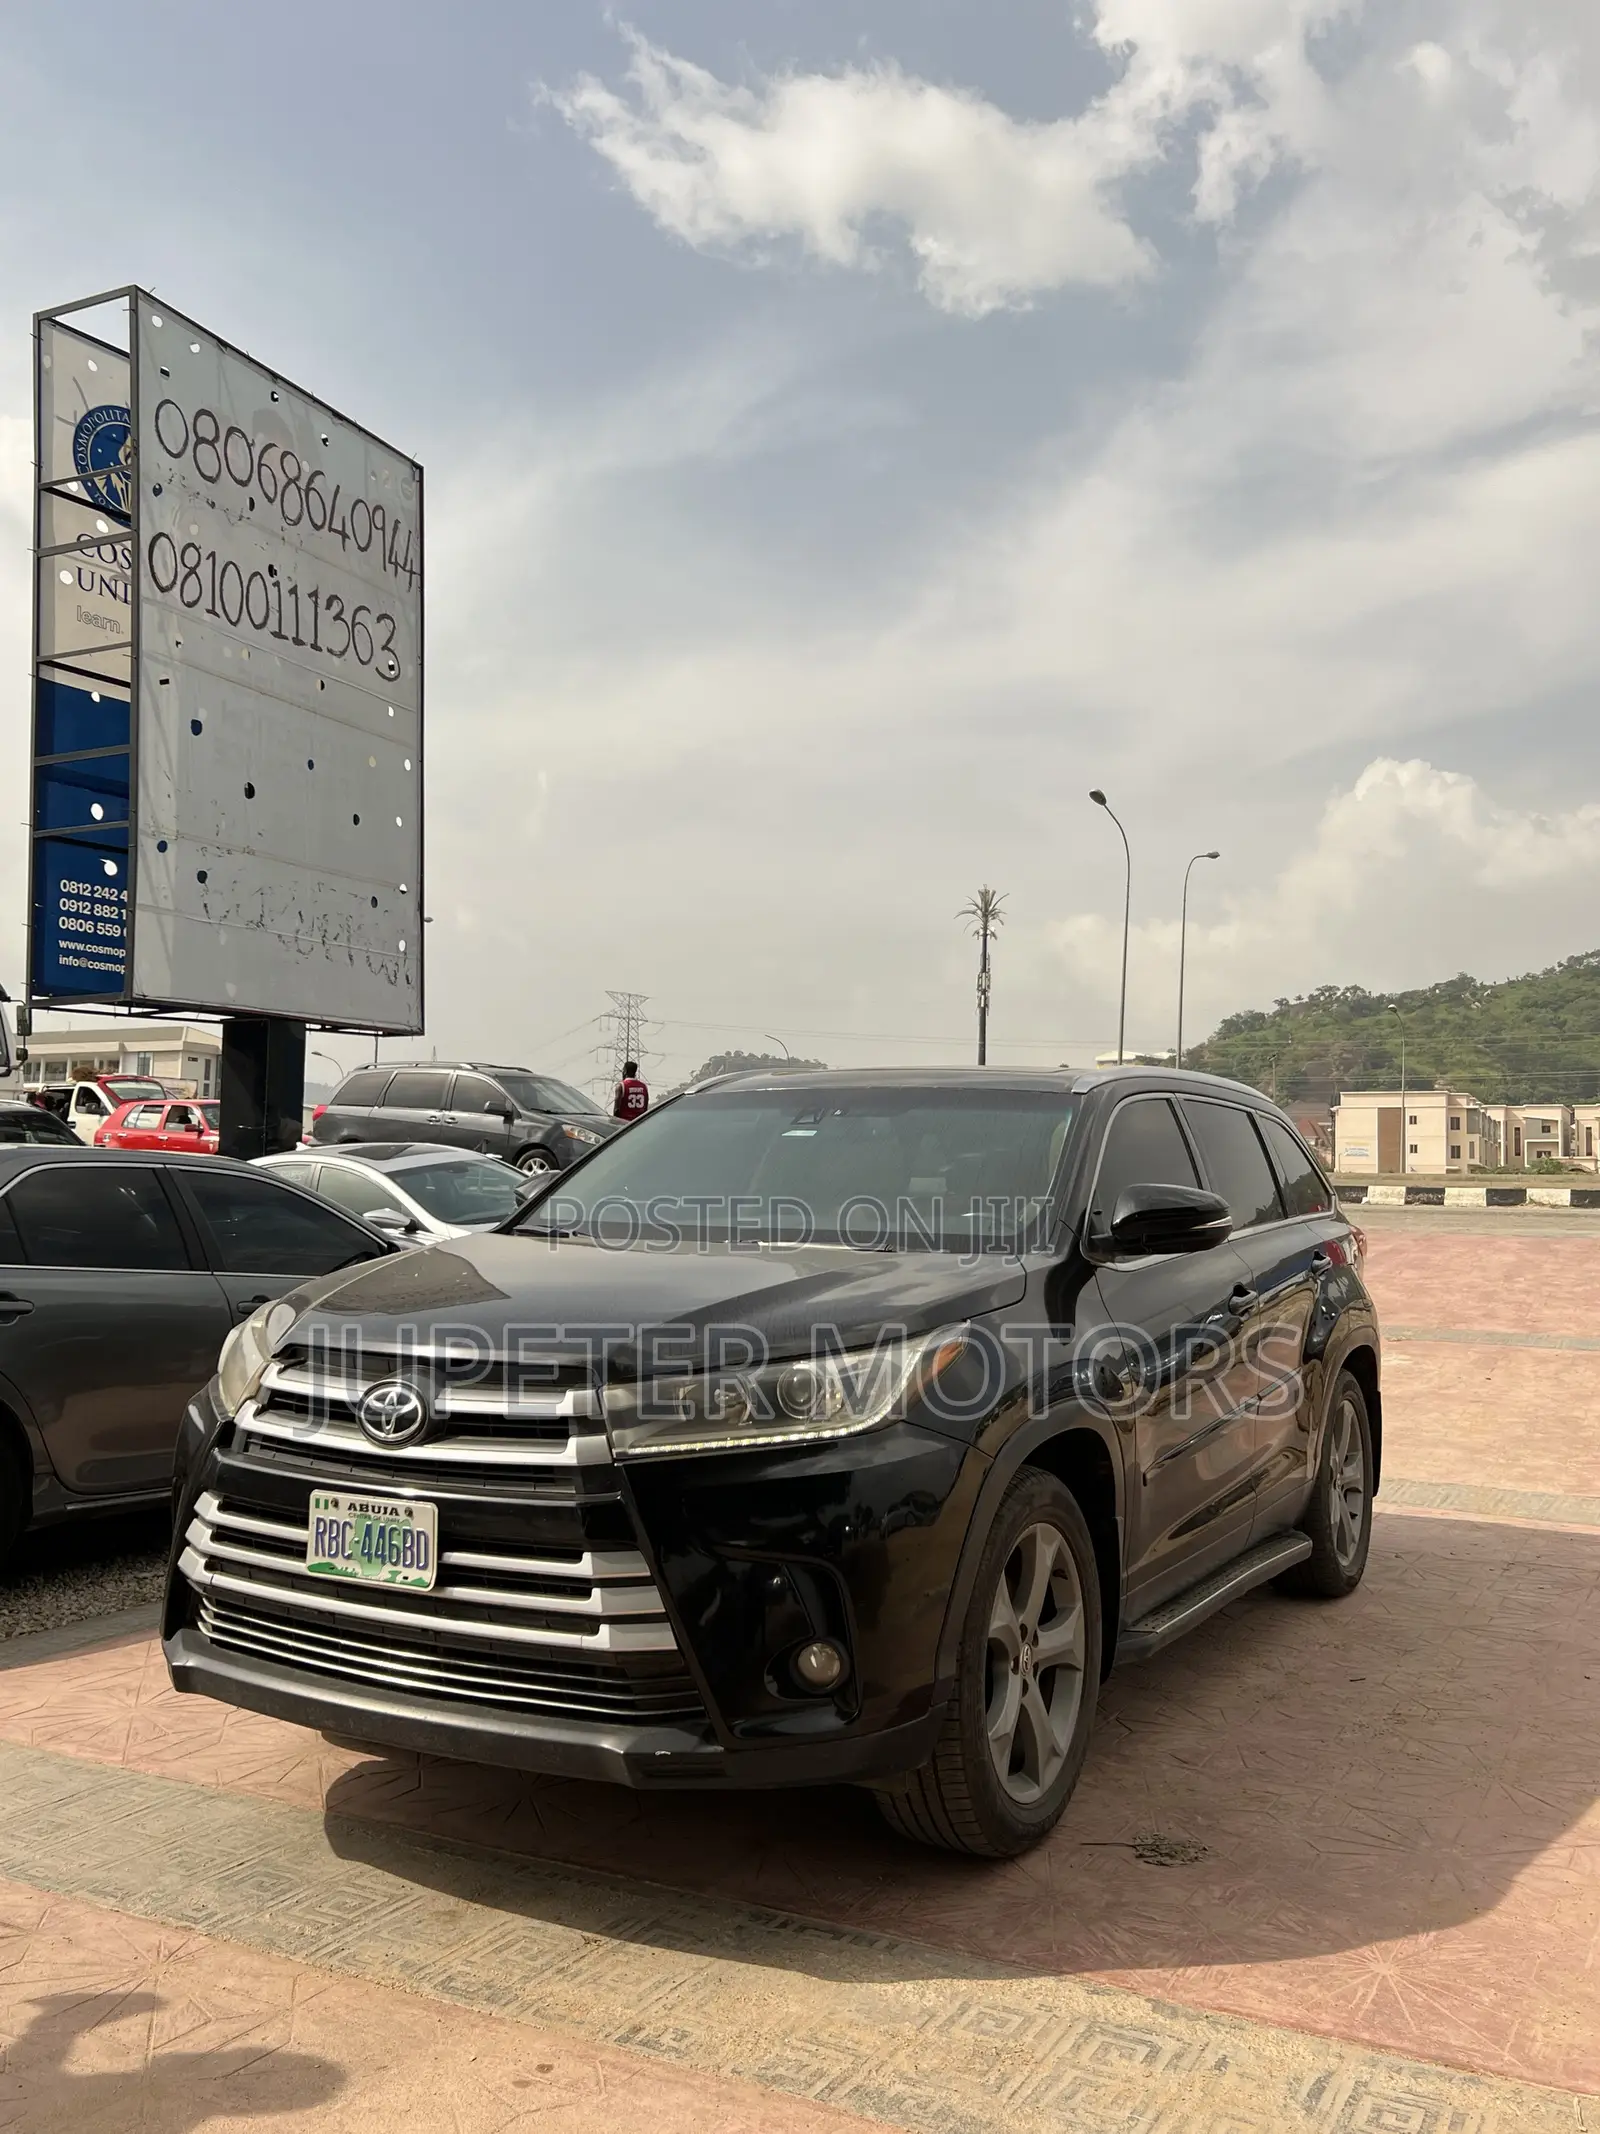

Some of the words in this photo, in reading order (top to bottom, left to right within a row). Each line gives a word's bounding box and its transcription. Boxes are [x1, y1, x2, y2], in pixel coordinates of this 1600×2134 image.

[155, 399, 420, 592] 08068640944
[148, 532, 401, 682] 08100111363
[76, 605, 124, 634] learn.
[60, 879, 92, 897] 0812
[93, 886, 118, 901] 242
[59, 898, 91, 915] 0912
[93, 903, 119, 919] 882
[59, 916, 94, 934] 0806
[96, 922, 121, 937] 559
[58, 939, 126, 959] www.cosmop
[628, 1094, 645, 1109] 33
[347, 1502, 400, 1517] ABUJA
